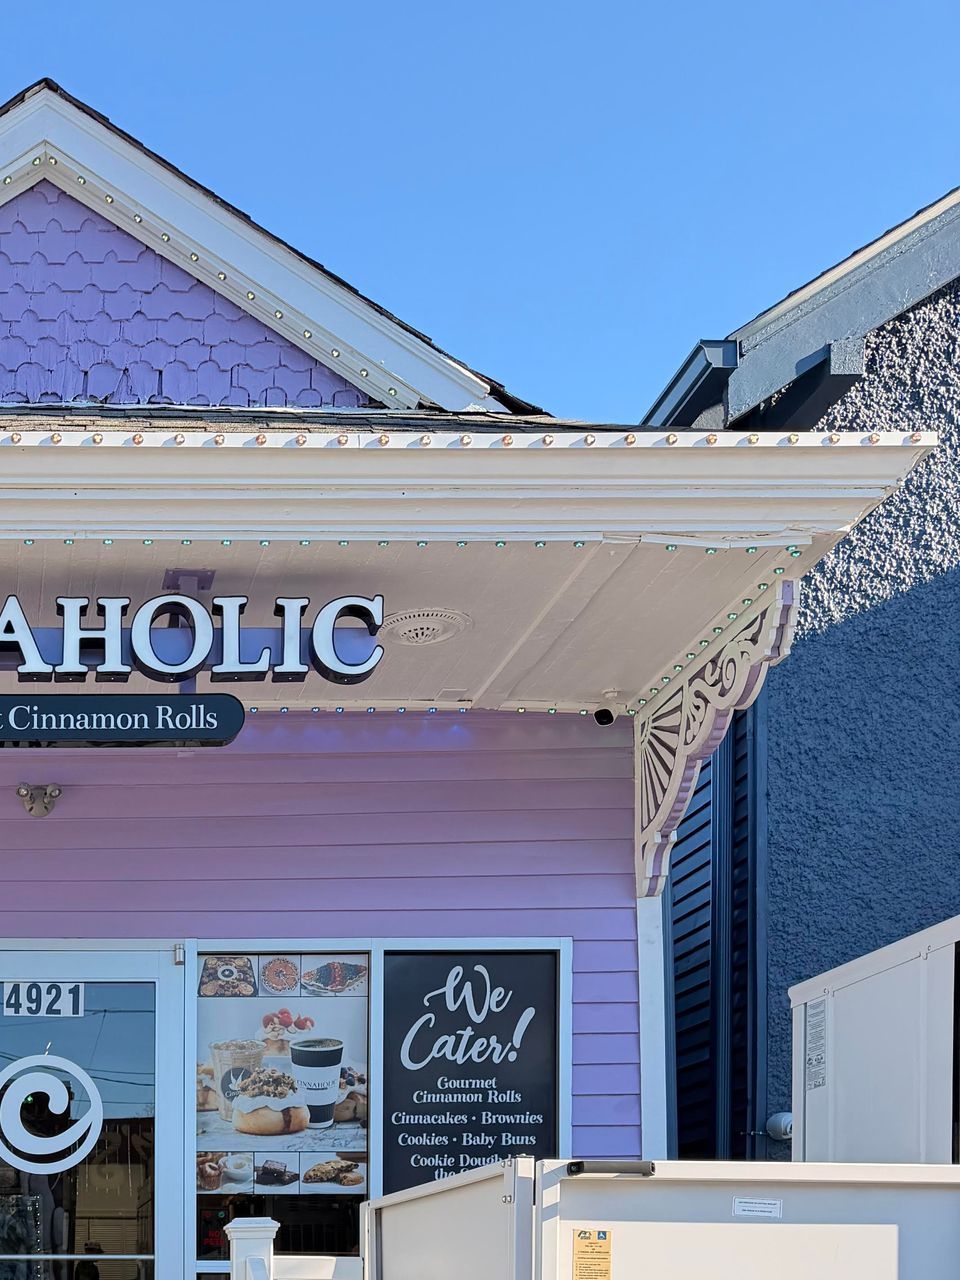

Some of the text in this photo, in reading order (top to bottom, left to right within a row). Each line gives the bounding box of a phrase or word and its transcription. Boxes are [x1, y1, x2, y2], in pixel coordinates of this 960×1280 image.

[8, 704, 150, 731] Cinnamon
[154, 704, 218, 730] Rolls
[5, 983, 81, 1016] 4921
[423, 964, 513, 1024] We
[400, 1006, 536, 1071] Cater!
[436, 1076, 497, 1090] Gourmet
[412, 1090, 522, 1104] Cinnamon Rolls
[391, 1111, 544, 1125] Cinnacakes Brownies
[397, 1132, 537, 1148] Cookies Baby Buns
[410, 1153, 455, 1168] Cookie
